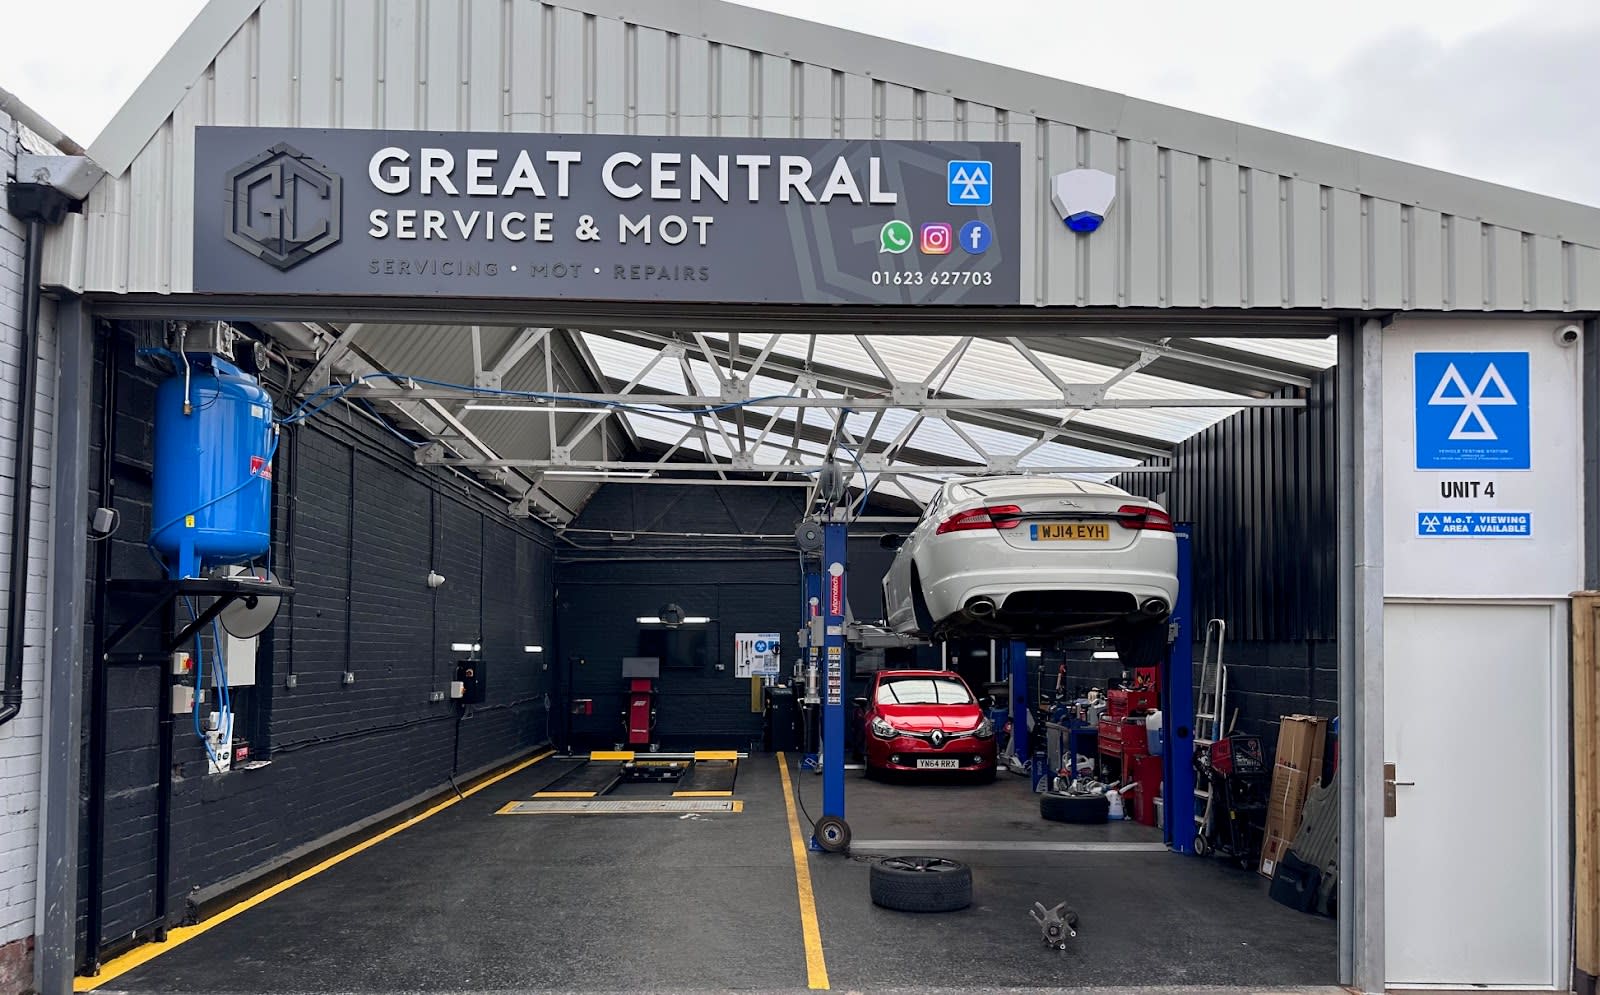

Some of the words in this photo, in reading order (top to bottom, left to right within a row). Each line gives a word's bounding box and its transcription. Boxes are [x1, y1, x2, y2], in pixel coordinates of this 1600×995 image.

[368, 147, 582, 197] GREAT
[602, 152, 898, 203] CENTRAL
[368, 209, 554, 241] SERVICE
[575, 214, 600, 241] &
[619, 214, 714, 245] MOT
[368, 258, 498, 277] SERVICING
[530, 262, 583, 279] MOT
[613, 264, 710, 281] REPAIRS
[872, 271, 923, 285] 01623
[930, 271, 992, 285] 627703
[1441, 481, 1480, 498] UNIT
[1484, 481, 1495, 498] 4
[1043, 525, 1072, 538] WJ14
[1077, 525, 1104, 538] EYH
[921, 759, 939, 767] YN64
[941, 759, 955, 767] RRX
